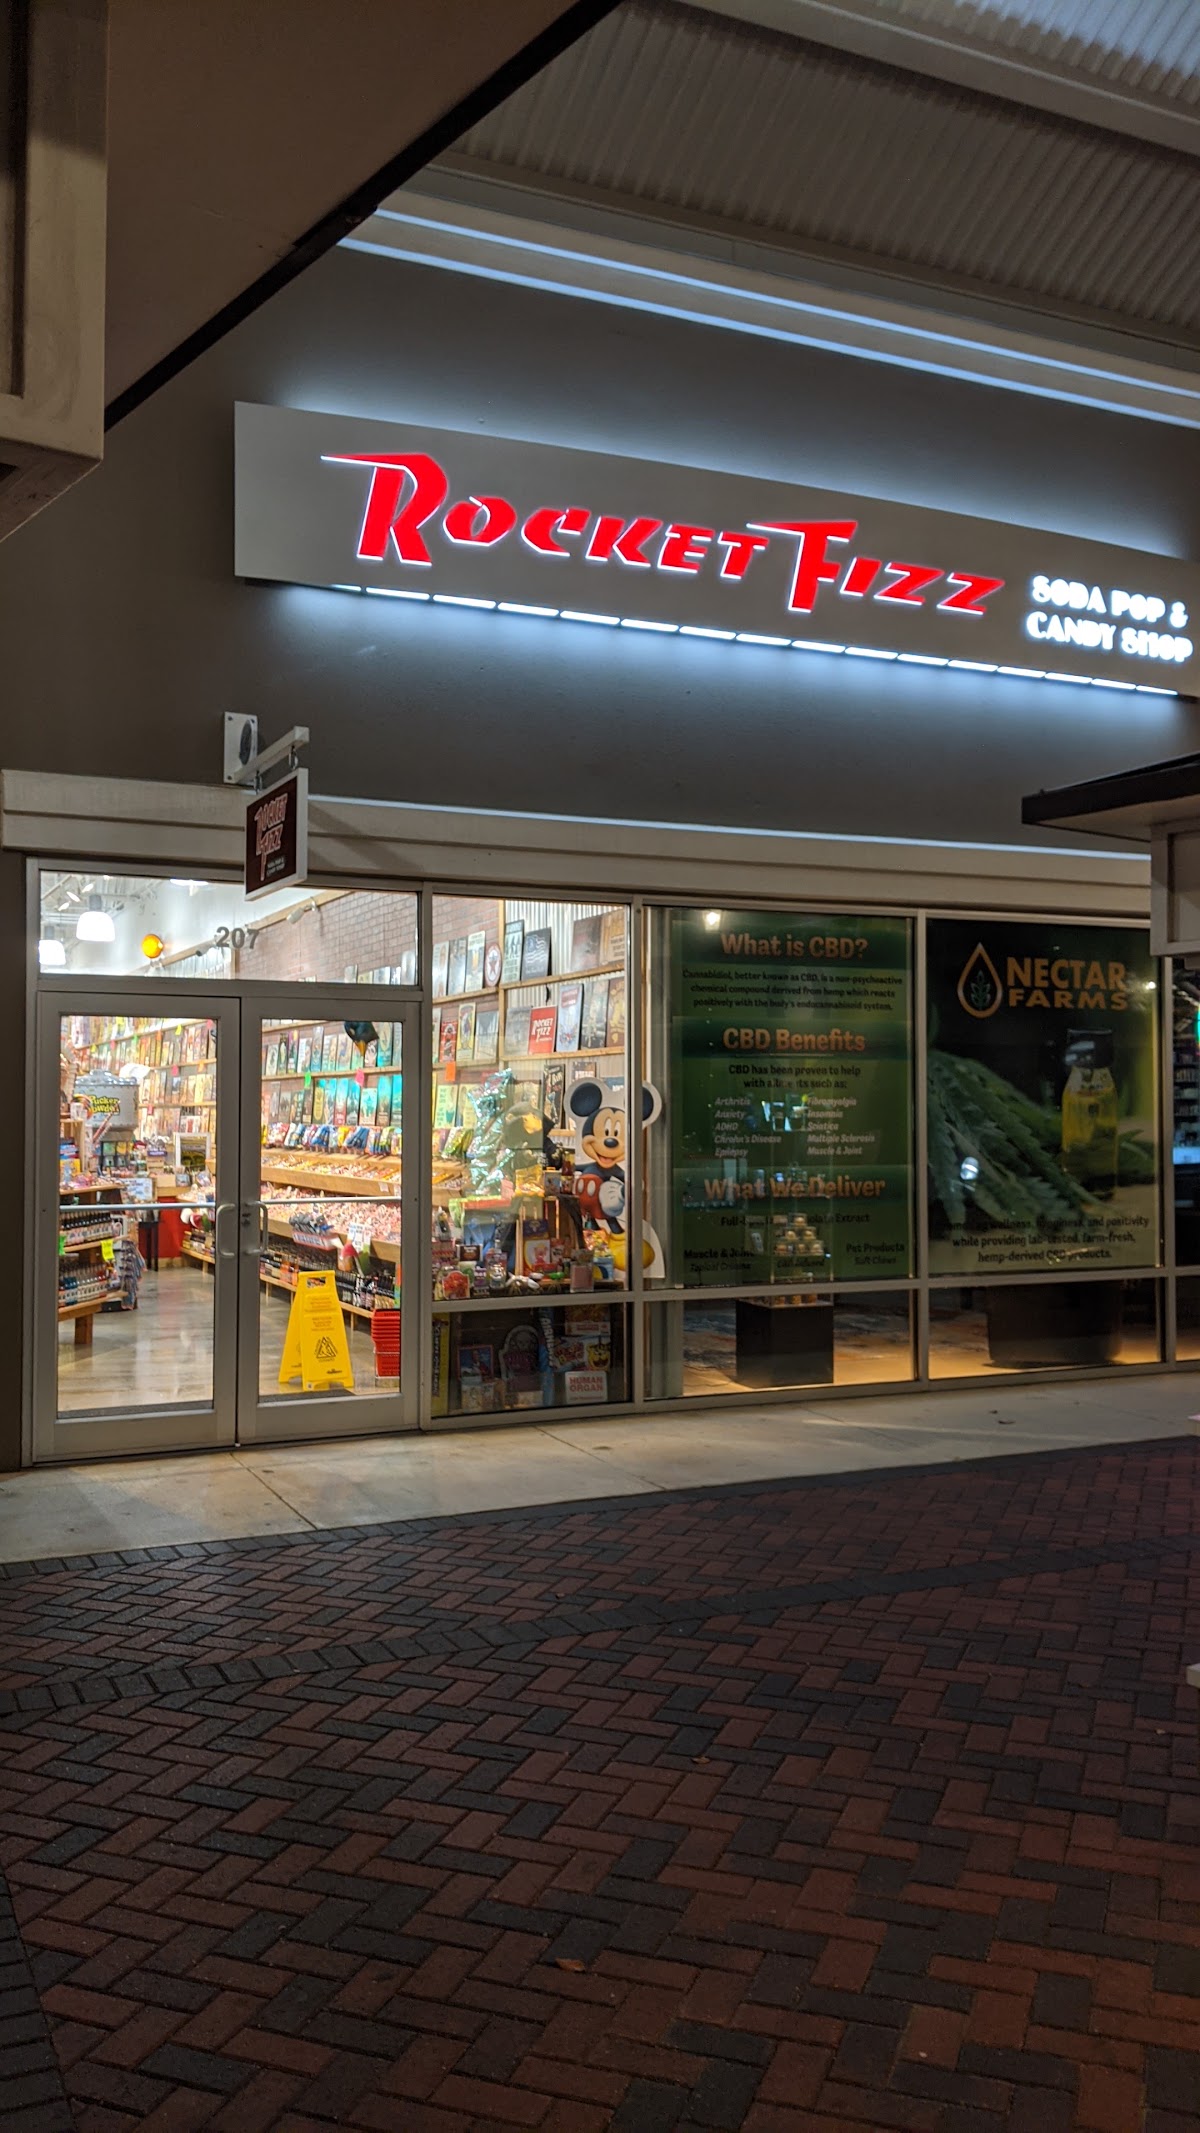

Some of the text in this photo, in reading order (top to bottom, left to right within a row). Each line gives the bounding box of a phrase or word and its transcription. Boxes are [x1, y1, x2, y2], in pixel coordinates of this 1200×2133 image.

[320, 452, 1005, 616] ROCKET FIZZ
[1032, 575, 1188, 628] SODA POP &
[1026, 611, 1193, 662] CANDY SHOP
[216, 926, 259, 949] 207
[720, 933, 869, 961] What is CBD?
[1007, 956, 1128, 990] NECTAR
[1008, 990, 1129, 1011] FARMS
[722, 1027, 866, 1052] CBD Benefits
[728, 1064, 861, 1077] CBD has been proven to help
[743, 1078, 765, 1088] with
[810, 1079, 832, 1088] such
[714, 1097, 751, 1106] Arthritis
[714, 1110, 746, 1120] Anxiety
[807, 1109, 844, 1118] Insomnia
[714, 1122, 738, 1131] ADHD
[807, 1145, 863, 1155] Muscle & Joint
[704, 1174, 886, 1201] What We Deliver
[835, 1213, 870, 1223] Extract
[1105, 1215, 1149, 1228] positivity
[952, 1236, 979, 1247] while
[981, 1234, 1025, 1248] providing
[978, 1250, 1044, 1264] hemp-derived
[569, 1376, 603, 1385] HUMAN
[569, 1384, 603, 1392] ORGAN
